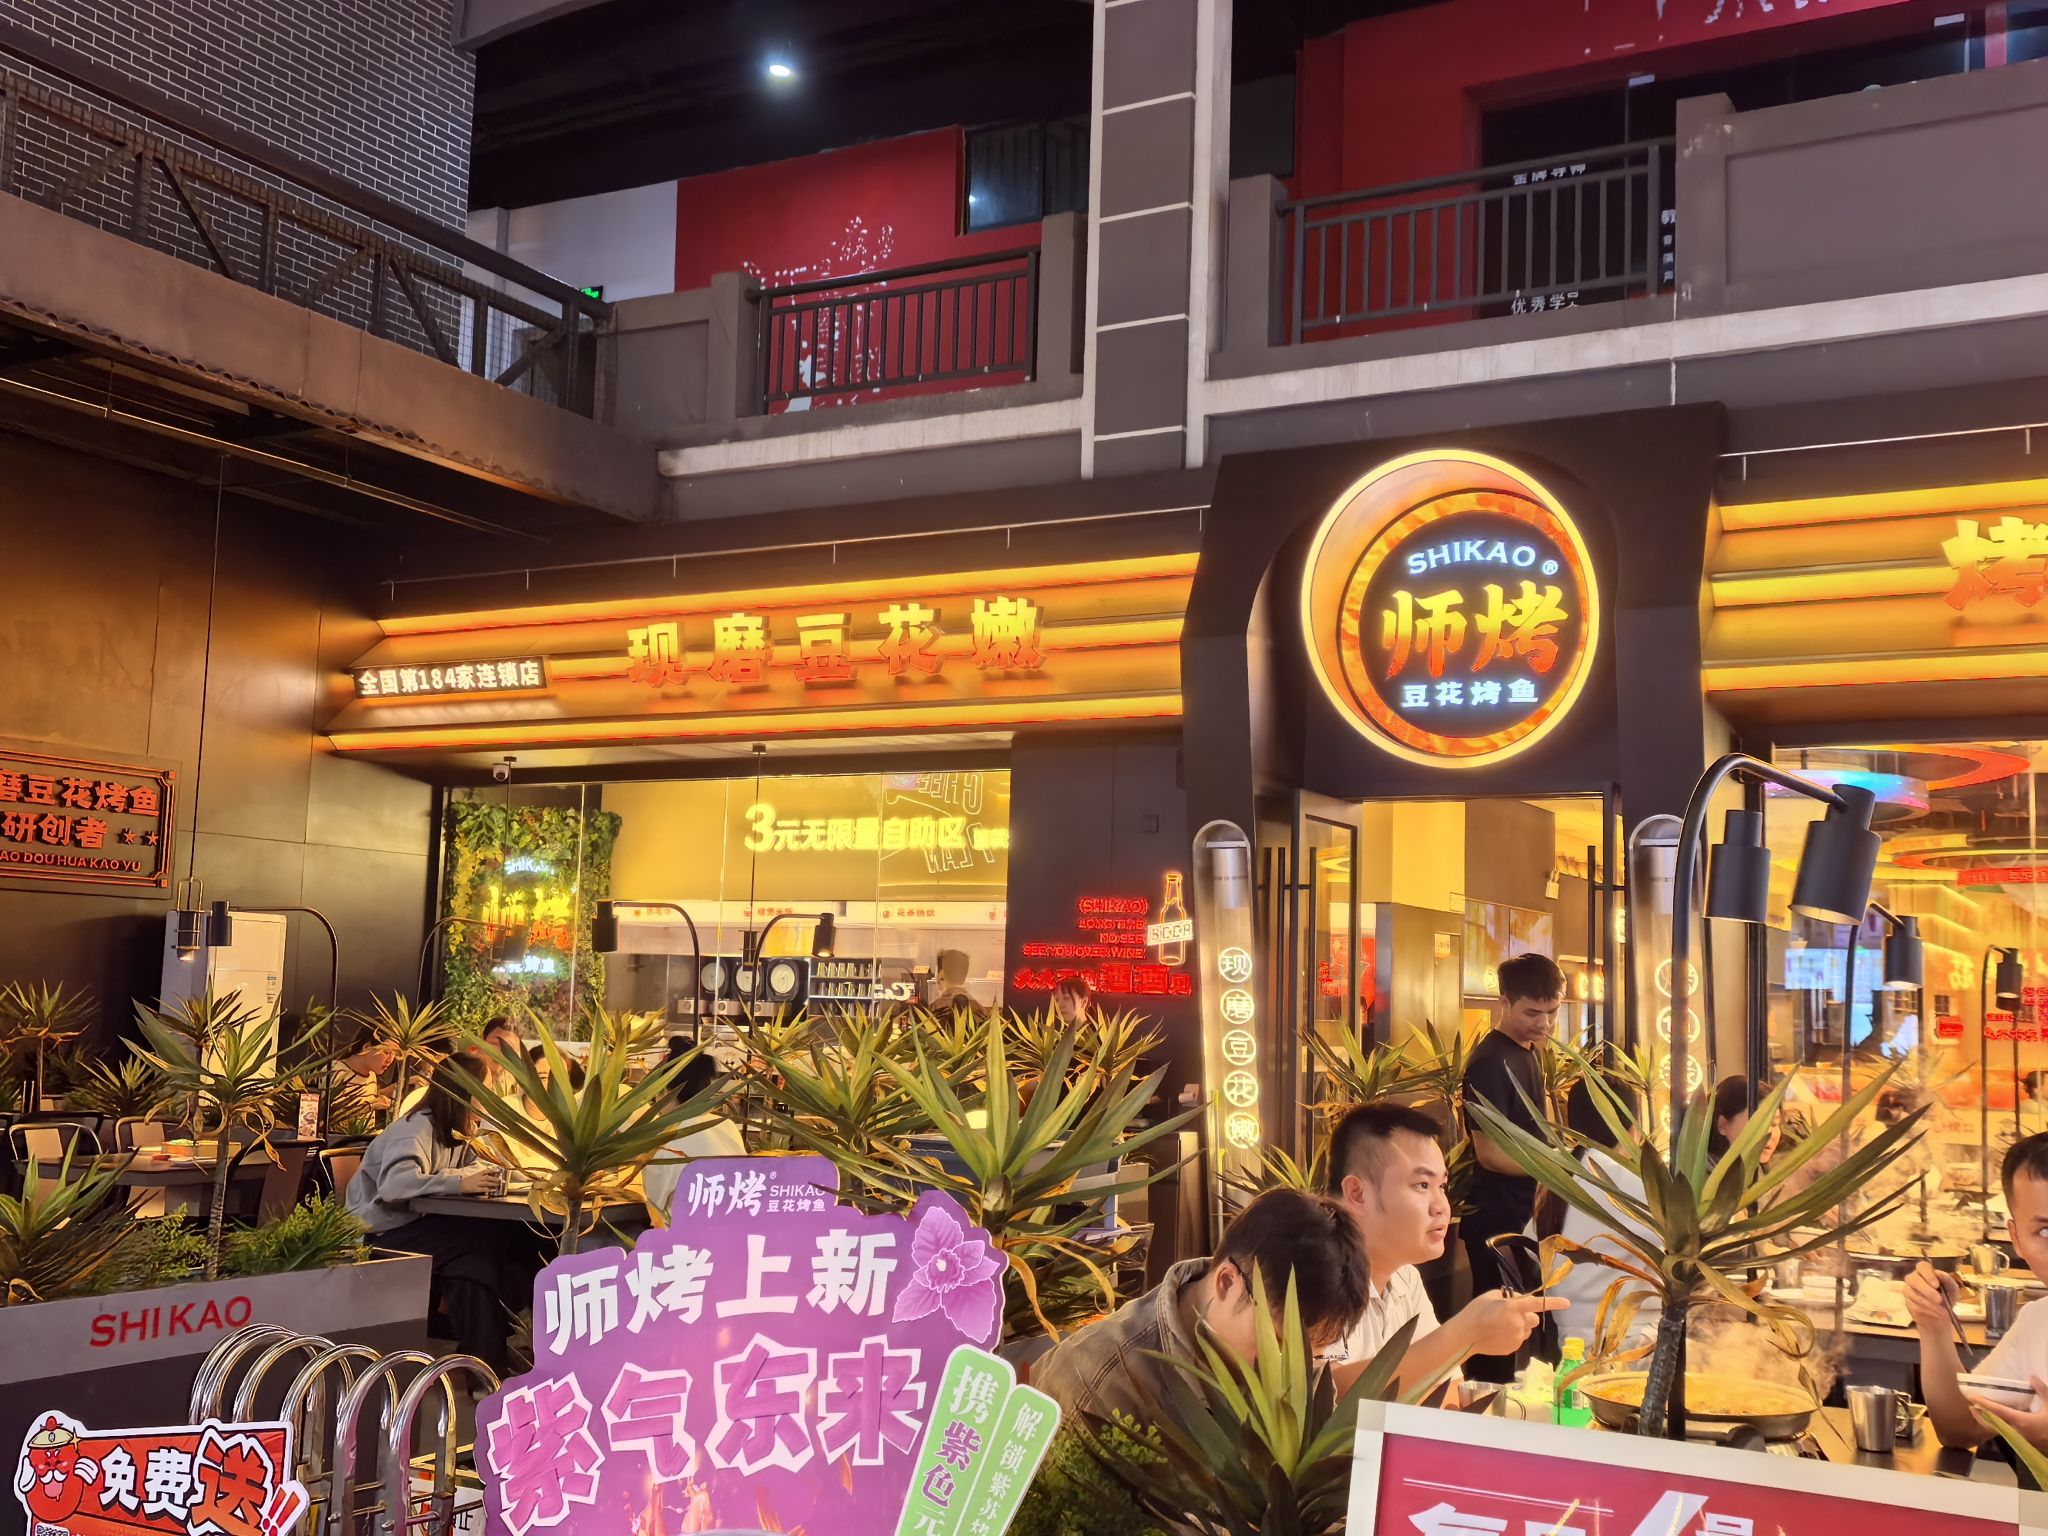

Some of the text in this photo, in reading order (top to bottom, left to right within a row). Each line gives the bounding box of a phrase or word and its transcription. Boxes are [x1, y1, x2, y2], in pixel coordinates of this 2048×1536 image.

[626, 595, 1048, 688] 现磨豆花嫩
[1381, 580, 1569, 680] 师烤
[358, 659, 542, 697] 全国第184家连锁店
[1401, 678, 1539, 708] 豆花烤鱼
[1, 811, 109, 849] 研创者
[744, 803, 967, 853] 3元无限量自助区
[24, 853, 55, 865] DOU
[57, 855, 87, 868] HUA
[90, 859, 120, 871] KAO
[123, 861, 142, 873] YU
[766, 1198, 826, 1213] 豆花烤鱼
[545, 1229, 898, 1356] 师烤上新
[90, 1295, 253, 1347] SHIKAO
[486, 1333, 926, 1535] 紫气东来
